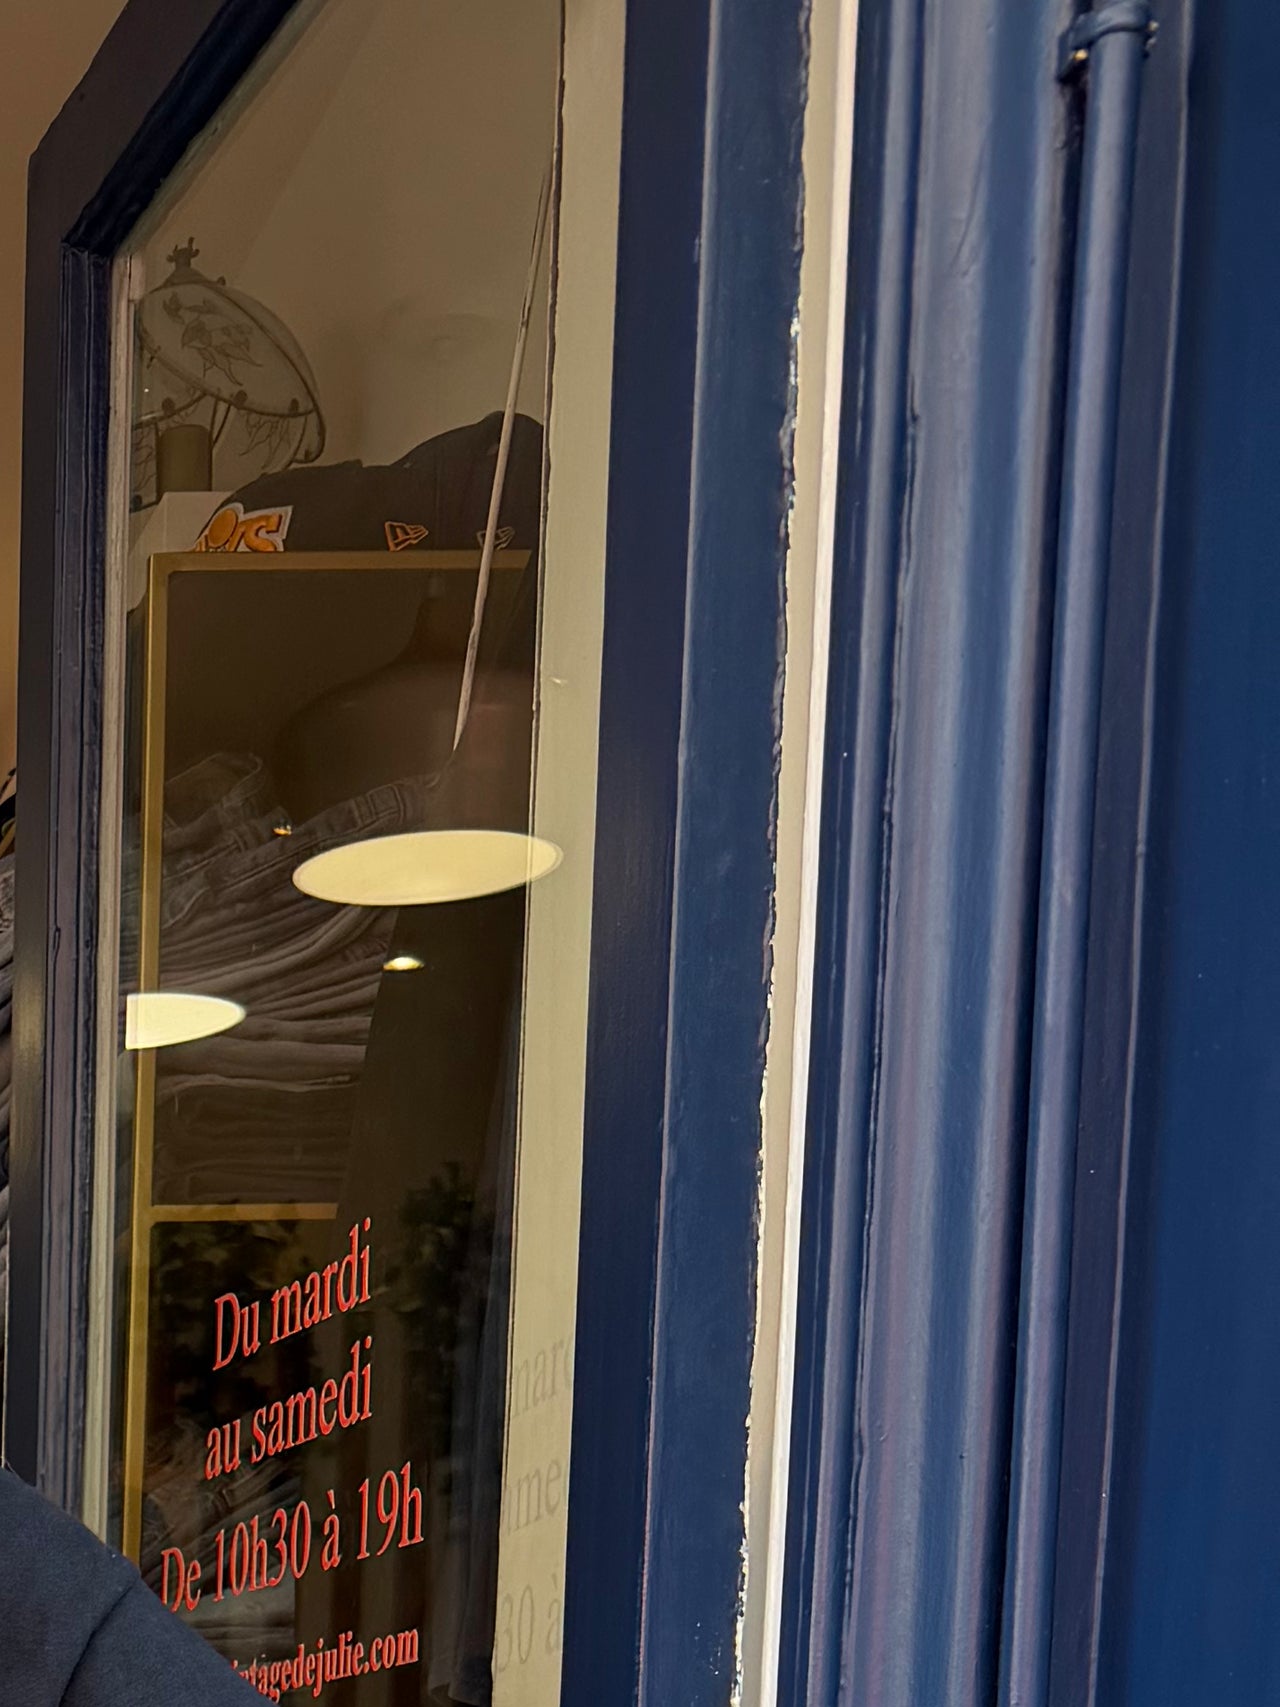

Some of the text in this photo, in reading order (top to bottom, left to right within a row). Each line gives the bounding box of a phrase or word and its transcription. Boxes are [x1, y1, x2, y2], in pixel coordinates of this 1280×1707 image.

[213, 1216, 371, 1371] Du mardi
[204, 1335, 372, 1480] au samedi
[161, 1547, 202, 1613] De
[214, 1500, 311, 1603] 10h30
[321, 1489, 342, 1571] à
[356, 1461, 424, 1560] 19h
[231, 1628, 419, 1704] tagedejulie.com
